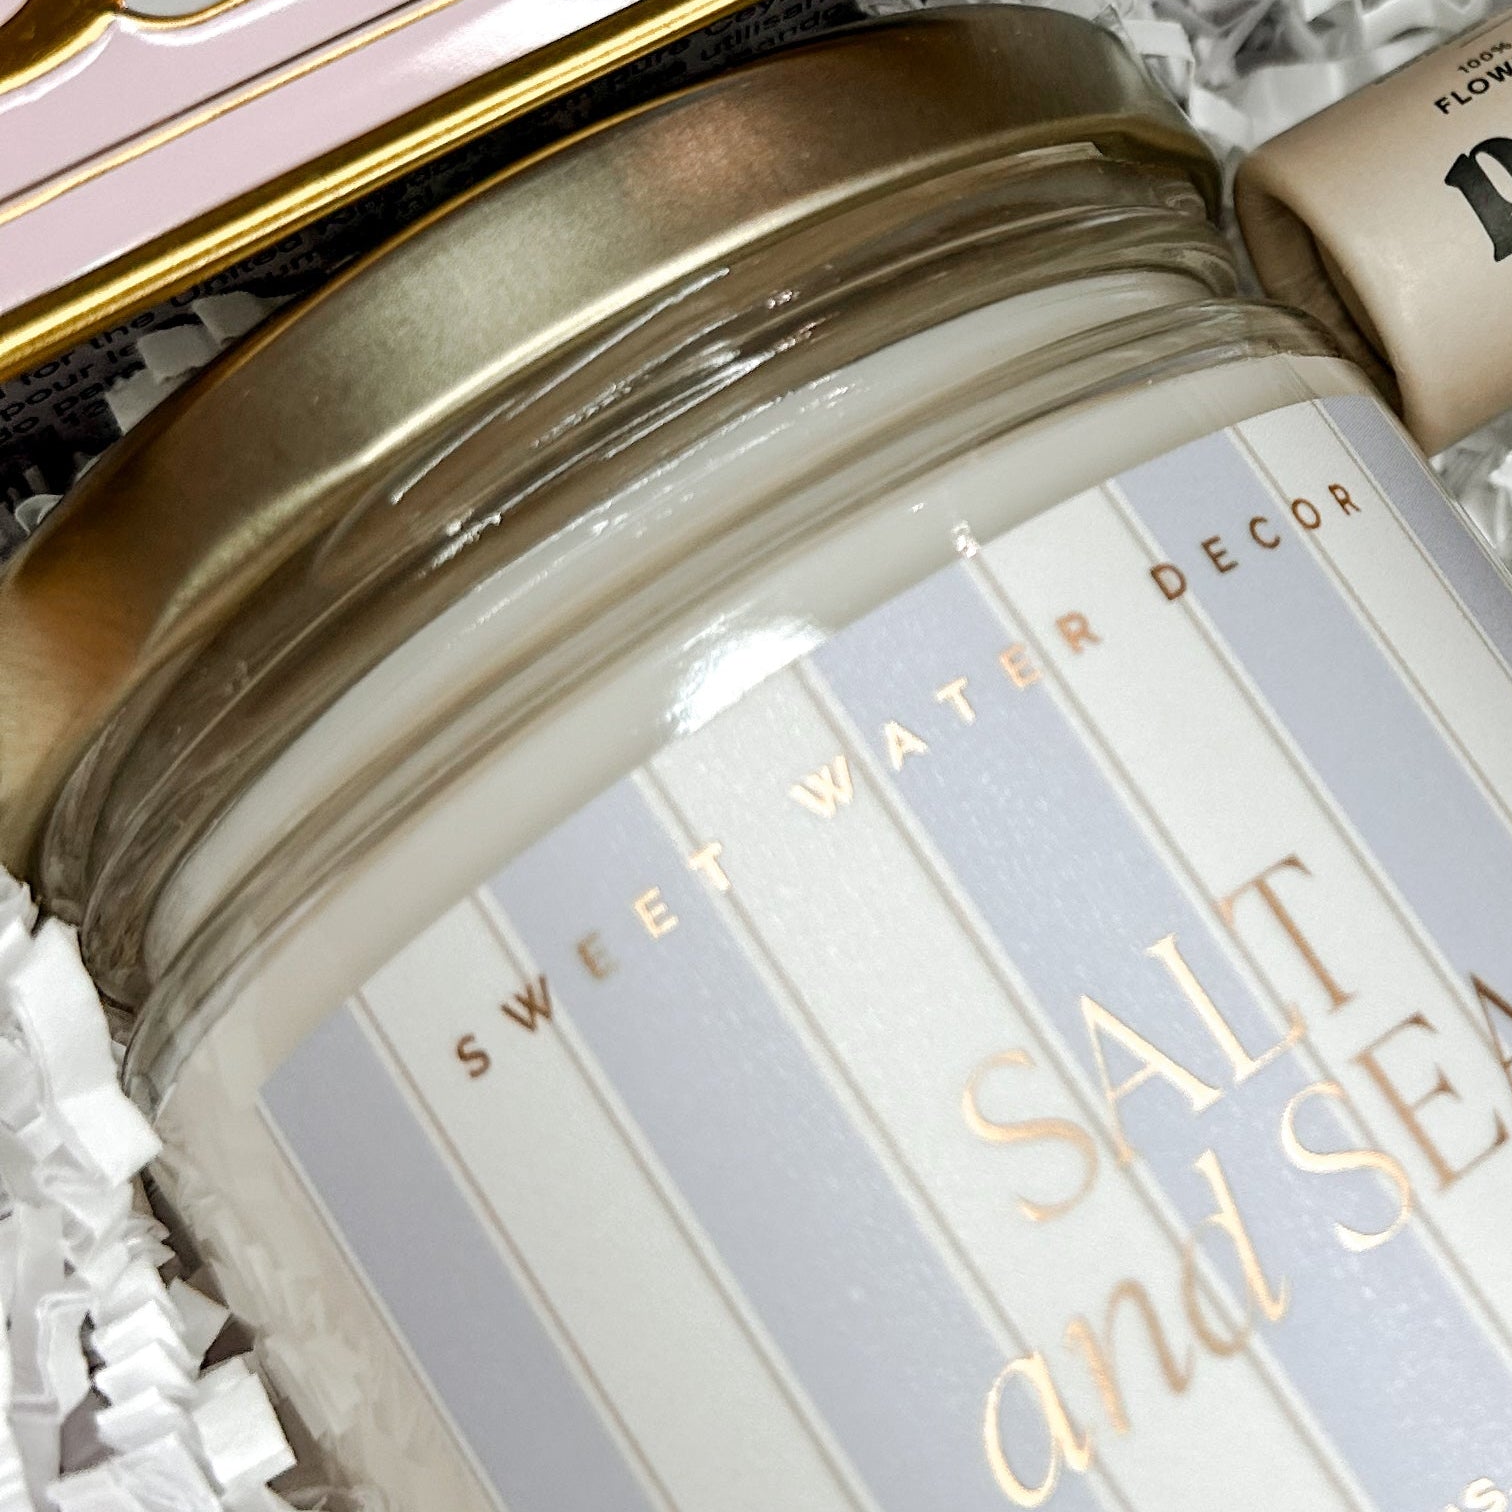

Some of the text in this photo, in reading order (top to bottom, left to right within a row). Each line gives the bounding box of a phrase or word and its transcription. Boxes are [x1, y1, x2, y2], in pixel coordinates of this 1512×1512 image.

[1457, 41, 1512, 75] 100%
[453, 482, 1361, 1080] SWEET WATER DECOR
[961, 853, 1355, 1225] SALT
[984, 1149, 1290, 1510] and
